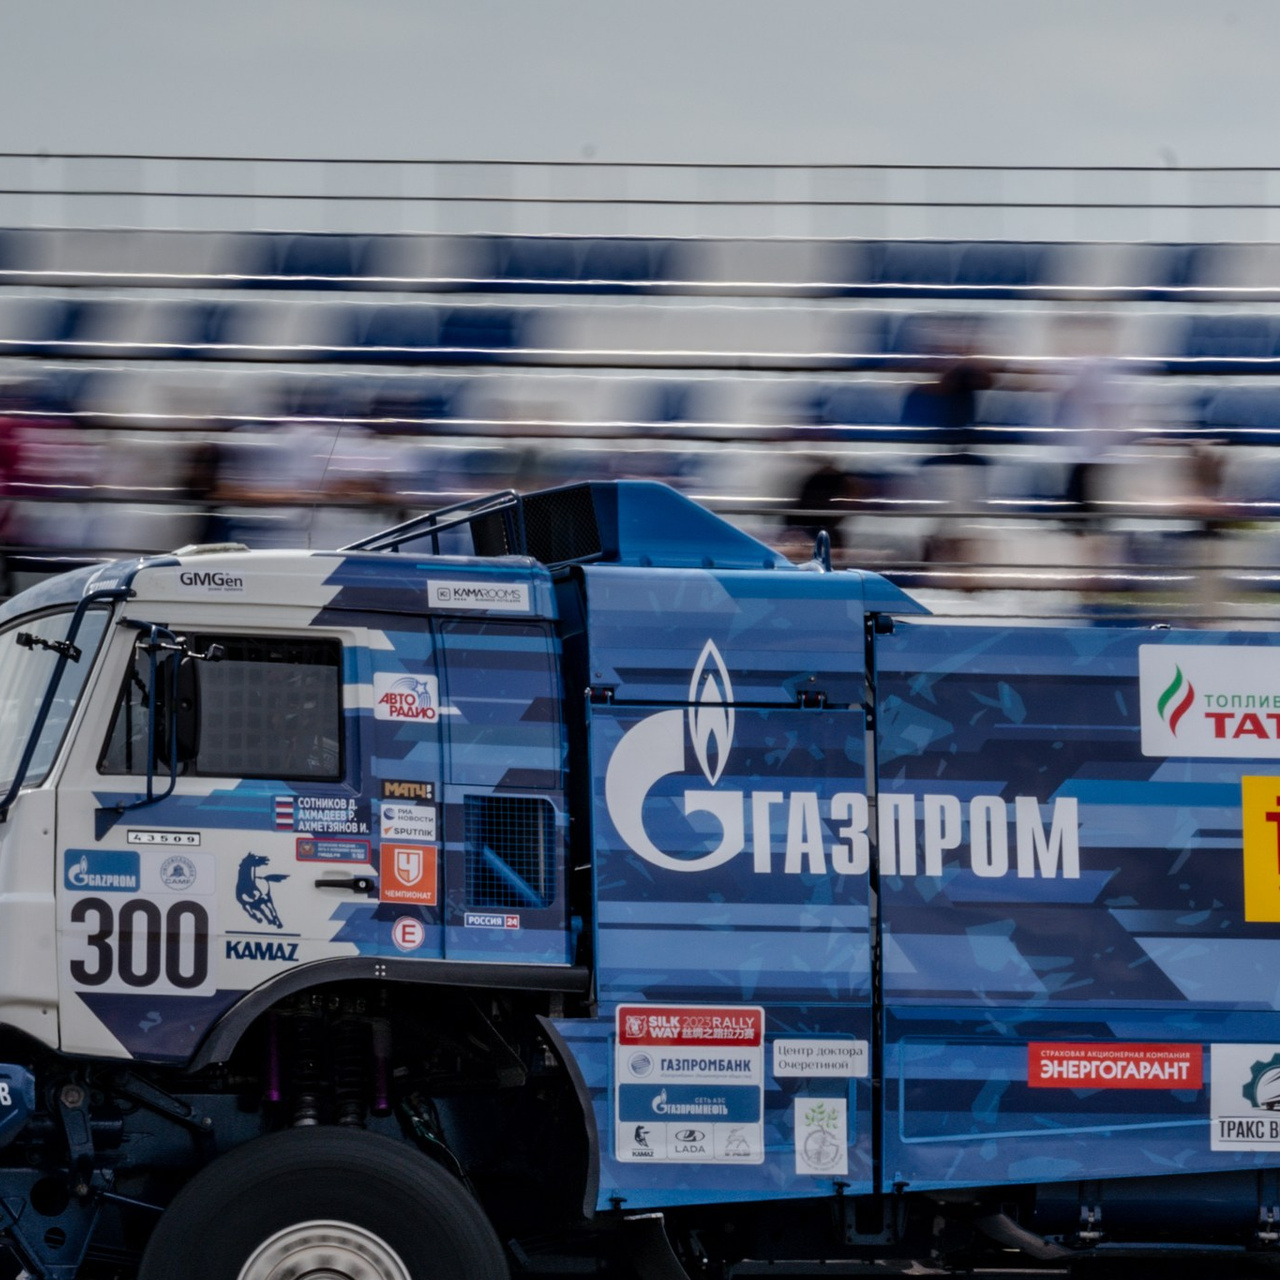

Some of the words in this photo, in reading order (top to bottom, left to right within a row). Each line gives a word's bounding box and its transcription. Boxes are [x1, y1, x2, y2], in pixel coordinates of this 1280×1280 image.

[180, 572, 243, 587] GMGen
[378, 692, 416, 706] АВТО
[389, 704, 436, 719] РАДИО
[298, 797, 347, 809] СОТНИКОВ
[348, 798, 358, 811] Д.
[298, 809, 346, 821] АХМАДЕЕВ
[347, 810, 357, 822] Р.
[398, 815, 434, 823] НОВОСТИ
[297, 820, 359, 833] АХМЕТЗЯНОВ
[359, 822, 370, 833] И.
[133, 834, 195, 843] 43509
[751, 790, 1081, 879] ГАЗПРОМ
[88, 873, 136, 888] GAZPROM
[384, 889, 432, 900] ЧЕМПИОНАТ
[468, 916, 502, 926] РОССИЯ
[506, 917, 518, 927] 24
[70, 897, 209, 989] 300
[225, 940, 299, 962] KAMAZ
[648, 1016, 681, 1027] SILK
[683, 1016, 711, 1028] 2023
[713, 1017, 755, 1028] RALLY
[649, 1027, 681, 1038] WAY
[778, 1045, 813, 1058] Центр
[816, 1047, 863, 1058] доктора
[1041, 1050, 1085, 1058] СТРАХОВАЯ
[1087, 1051, 1144, 1059] АКЦИОНЕРНАЯ
[1146, 1051, 1190, 1059] КОМПАНИЯ
[660, 1058, 752, 1073] ГАЗПРОМБАНК
[778, 1060, 849, 1071] Очеретиной
[1040, 1060, 1190, 1080] ЭНЕРГОГАРАНТ
[667, 1103, 728, 1115] ГАЗПРОМНЕФТЬ
[1219, 1120, 1265, 1139] ТРАКС
[675, 1145, 705, 1154] LADA
